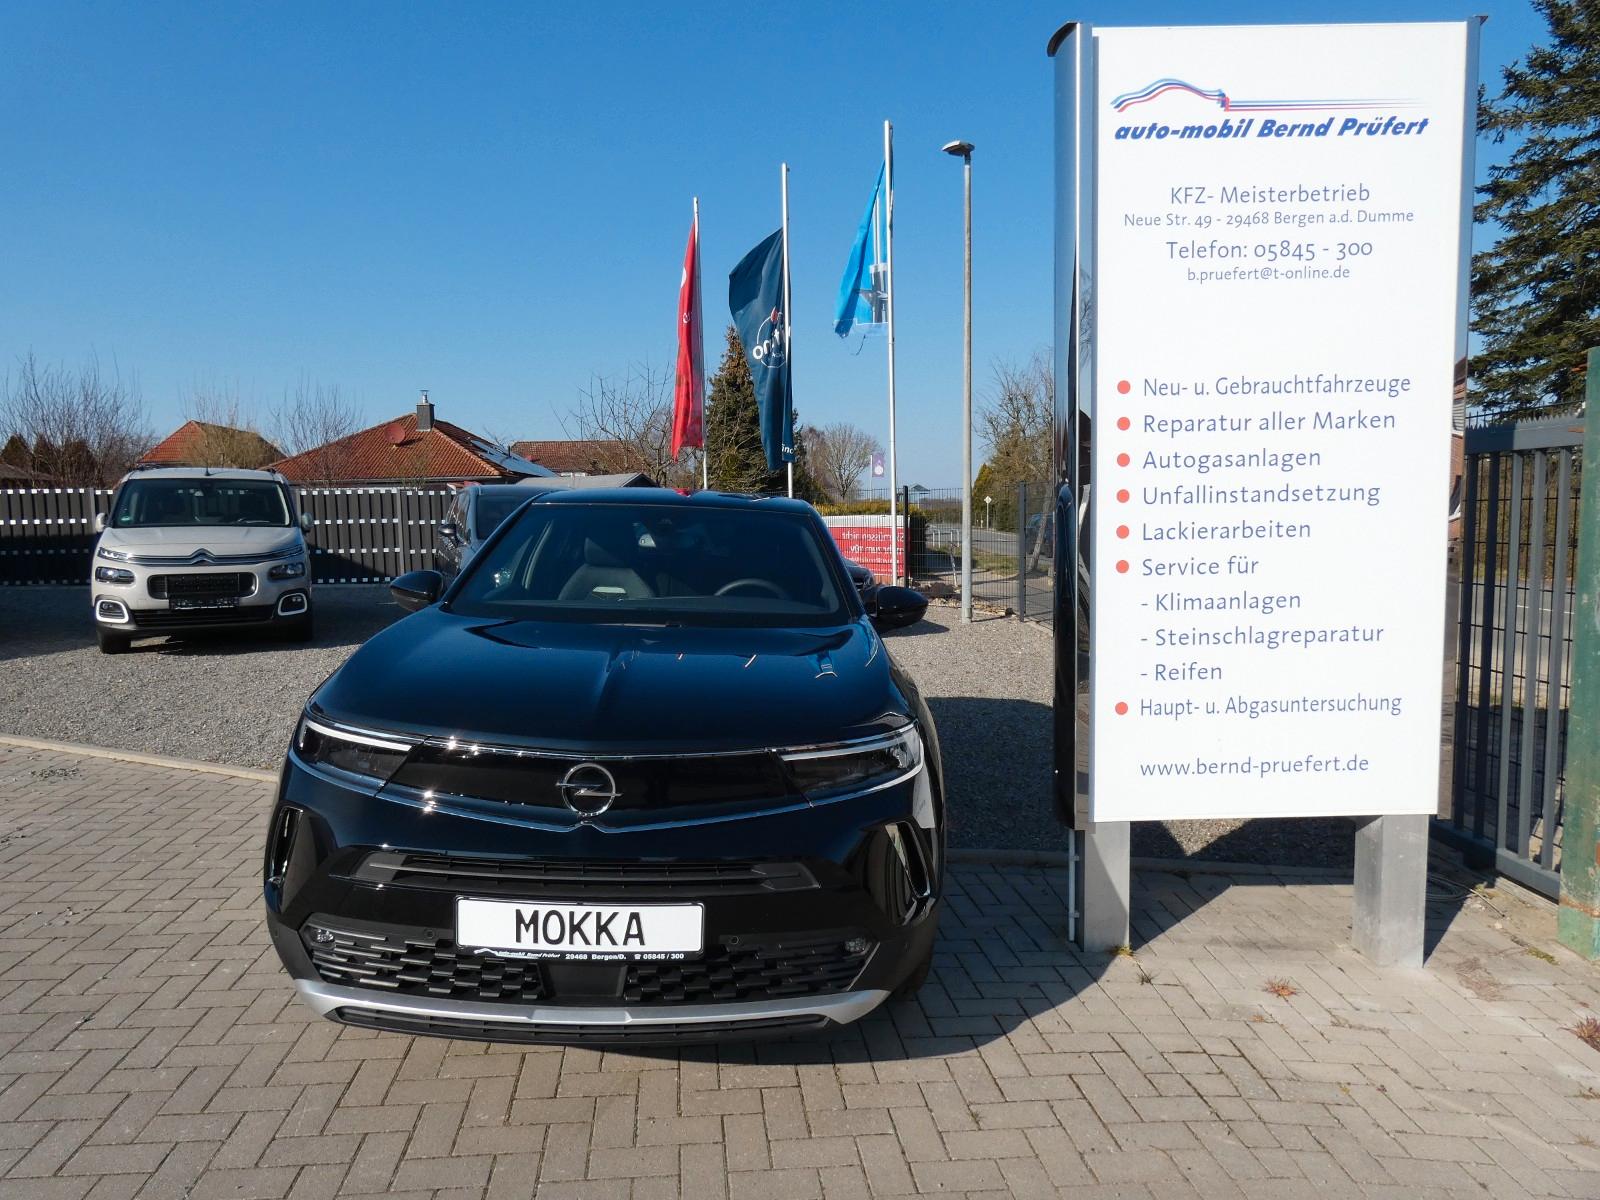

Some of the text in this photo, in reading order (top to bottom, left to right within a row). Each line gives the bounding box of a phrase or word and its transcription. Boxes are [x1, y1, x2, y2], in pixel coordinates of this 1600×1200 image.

[1114, 115, 1429, 140] auto-mobil Bernd Prüfert
[1170, 182, 1371, 205] KFZ- Meisterbetrieb
[1124, 213, 1162, 227] Neue
[1166, 213, 1191, 227] Str.
[1194, 215, 1212, 229] 49
[1226, 211, 1269, 228] 29468
[1274, 210, 1324, 228] Bergen
[1328, 209, 1353, 224] a.d.
[1357, 209, 1415, 224] Dumme
[1165, 240, 1248, 260] Telefon:
[1253, 239, 1316, 261] 05845
[1336, 241, 1374, 260] 300
[1187, 265, 1351, 285] b.pruefert@t-online.de
[1143, 373, 1412, 398] Neu- u. Gebrauchtfahrzeuge
[1143, 410, 1396, 438] Reparatur aller Marken
[1142, 448, 1322, 474] Autogasanlagen
[1143, 483, 1382, 507] Unfallinstandsetzung
[1142, 519, 1312, 541] Lackierarbeiten
[1142, 555, 1260, 577] Service für
[1155, 590, 1302, 615] Klimaanlagen
[1155, 625, 1385, 650] Steinschlagreparatur
[1155, 661, 1223, 682] Reifen
[1140, 693, 1403, 721] Haupt- u. Abgasuntersuchung
[1140, 754, 1370, 779] www.bernd-pruefert.de
[515, 909, 645, 946] MOKKA
